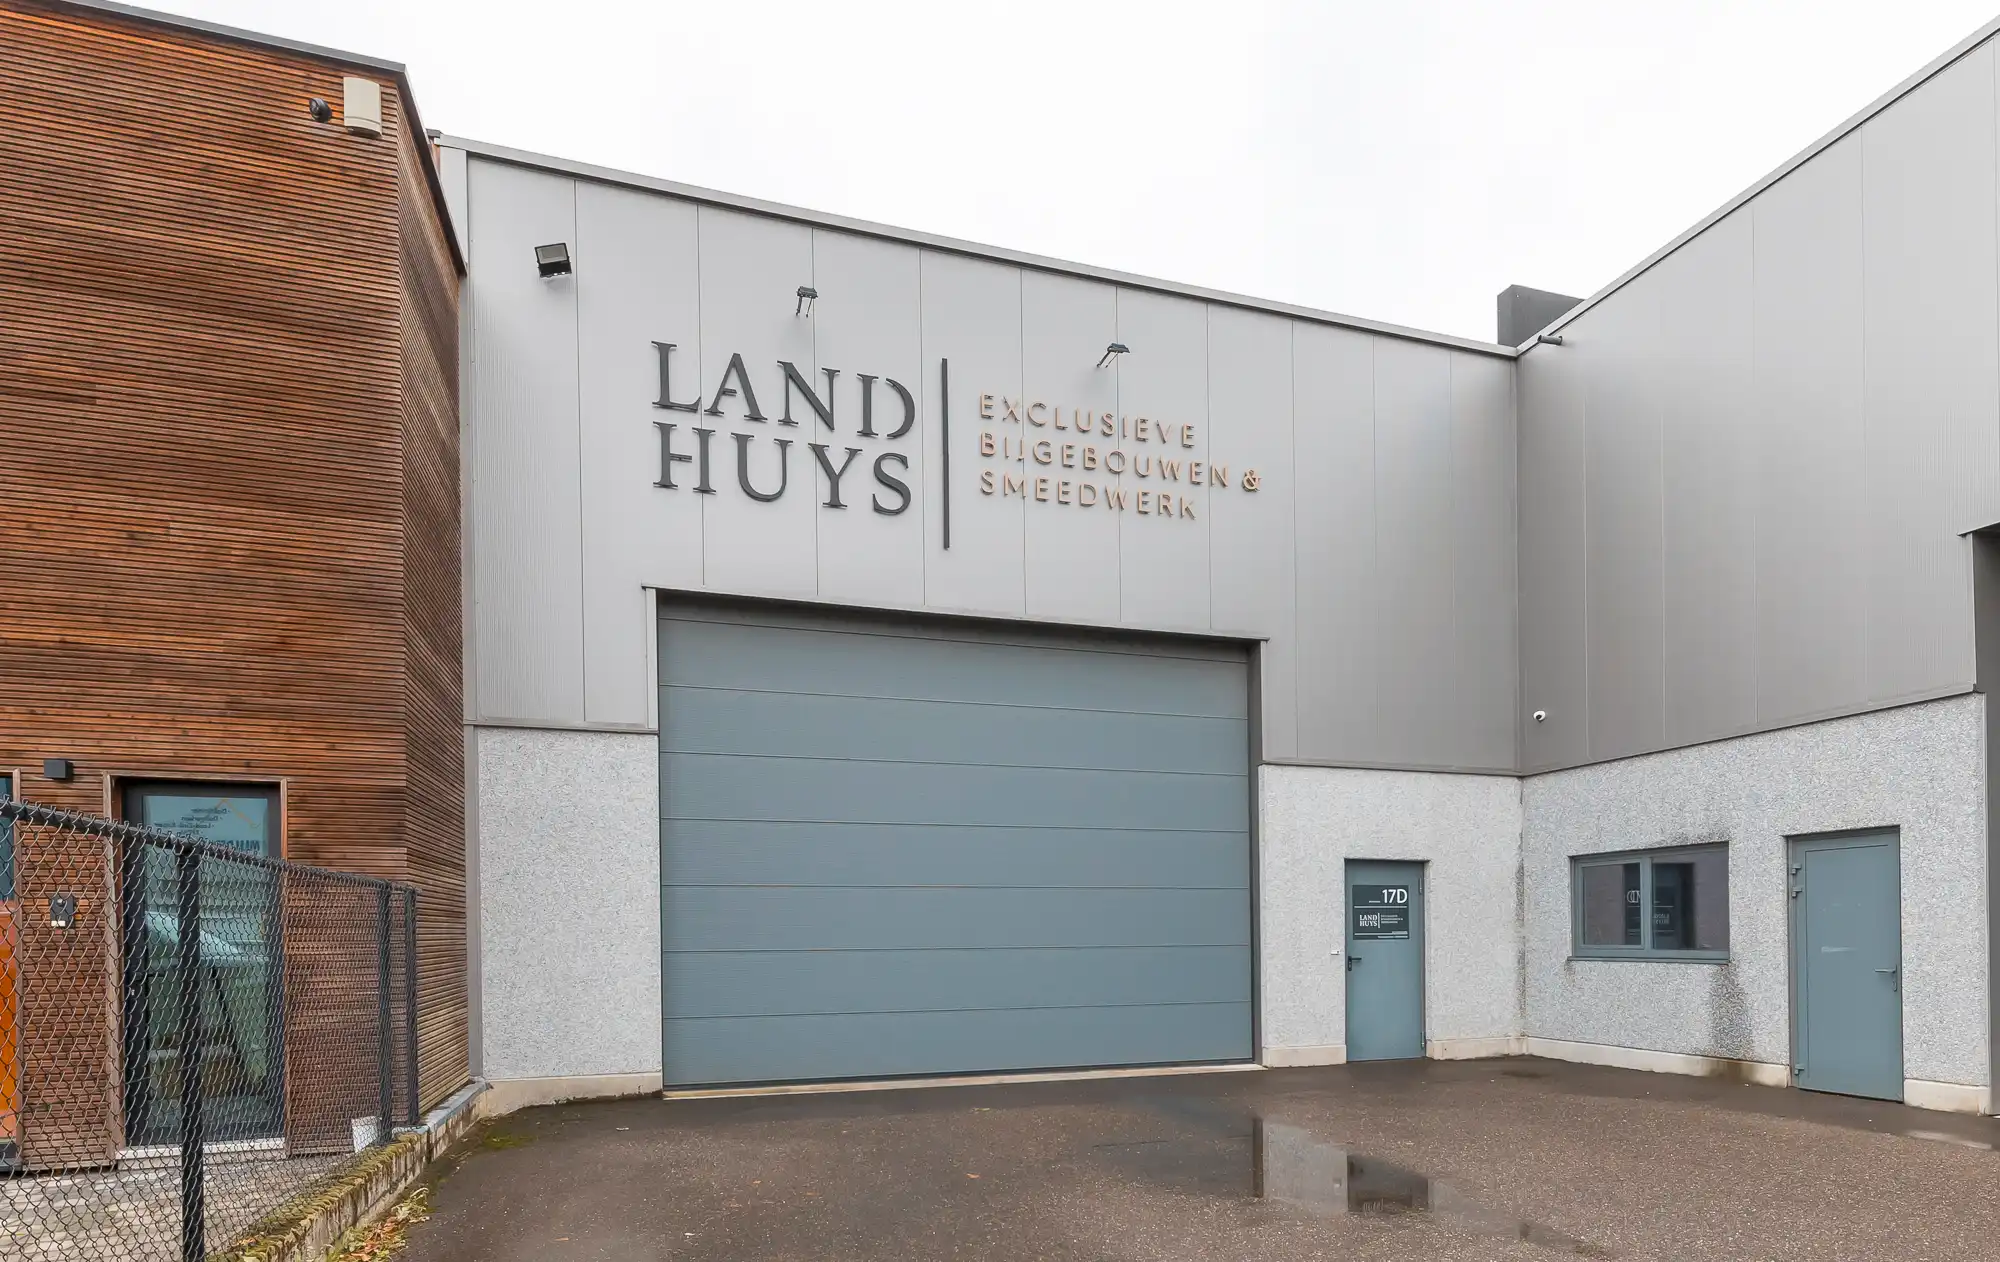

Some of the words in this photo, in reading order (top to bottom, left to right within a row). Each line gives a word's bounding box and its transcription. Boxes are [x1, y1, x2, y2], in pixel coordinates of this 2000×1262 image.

[651, 340, 915, 439] LAND
[980, 392, 1195, 449] EXCLUSIEVE
[652, 420, 911, 516] HUYS
[980, 431, 1229, 488] BIJGEBOUWEN
[1241, 467, 1262, 493] &
[980, 468, 1196, 520] SMEEDWERK
[1382, 888, 1408, 904] 17D
